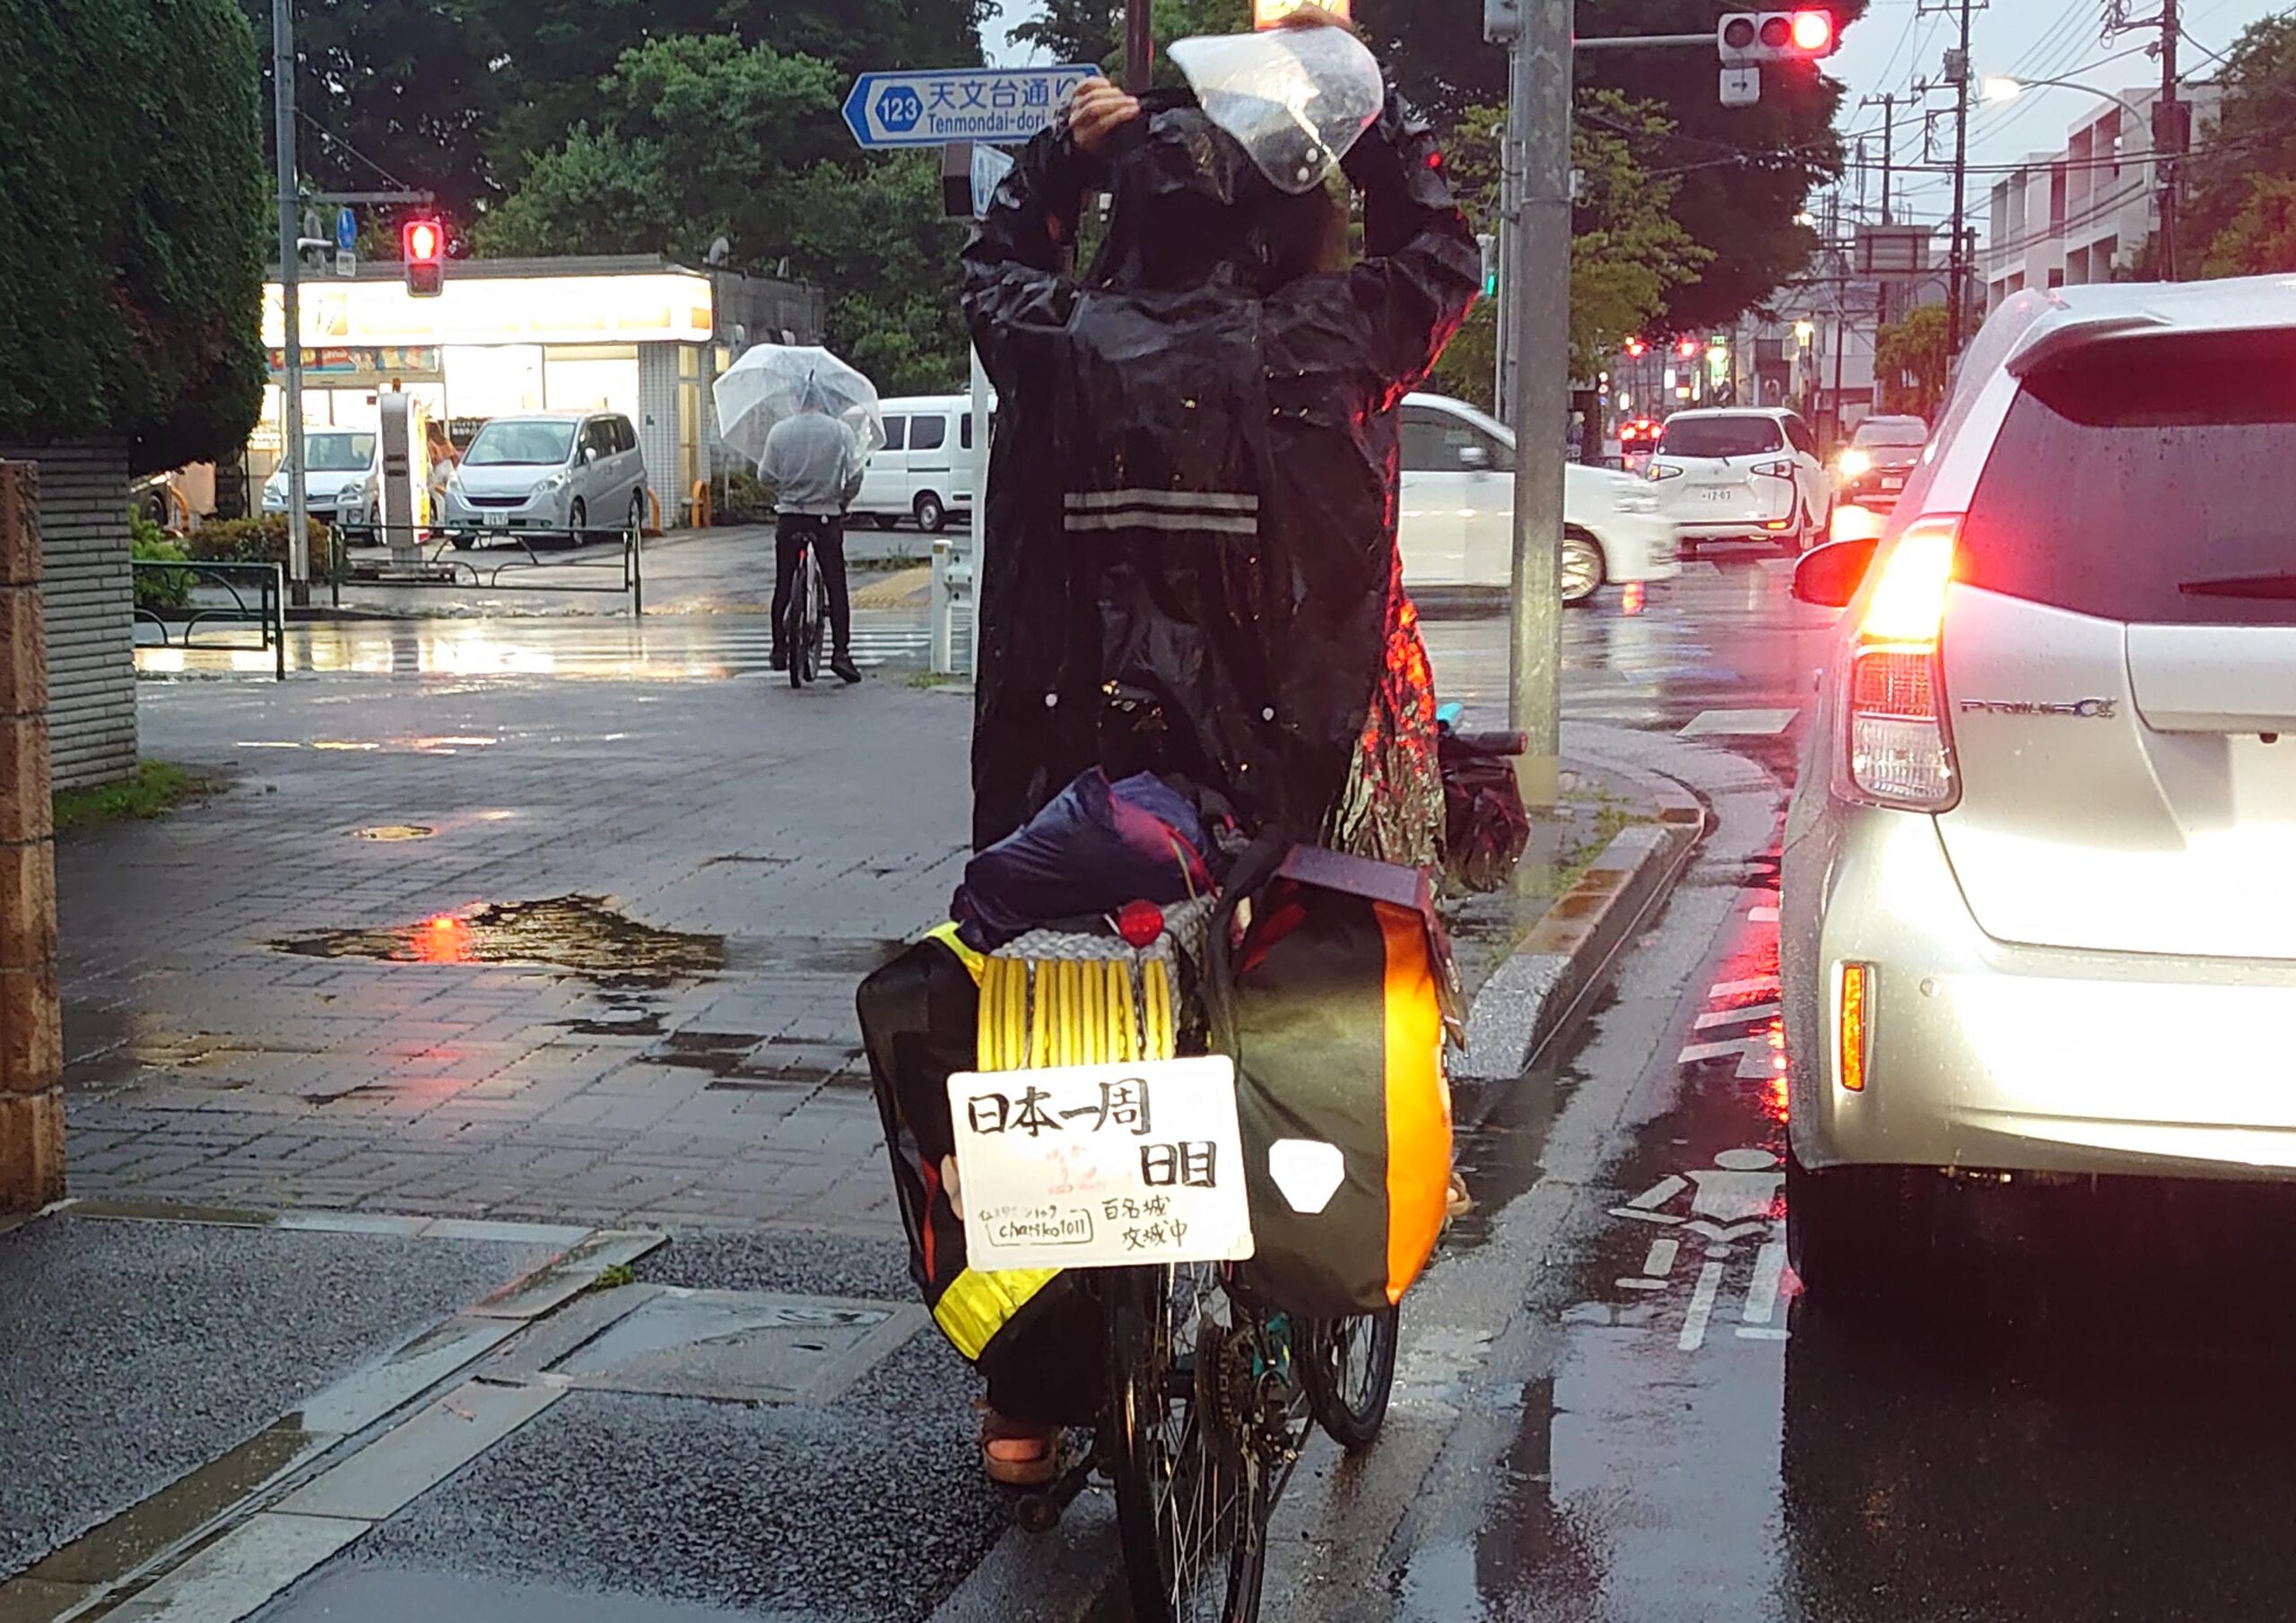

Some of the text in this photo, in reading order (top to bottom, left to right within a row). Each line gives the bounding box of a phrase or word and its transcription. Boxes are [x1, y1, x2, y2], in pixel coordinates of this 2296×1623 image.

[881, 98, 917, 123] 123
[968, 1078, 1152, 1137] 日本一周
[1140, 1141, 1217, 1188] 日目
[1101, 1194, 1171, 1220] 百名城
[1121, 1218, 1188, 1252] 攻城中
